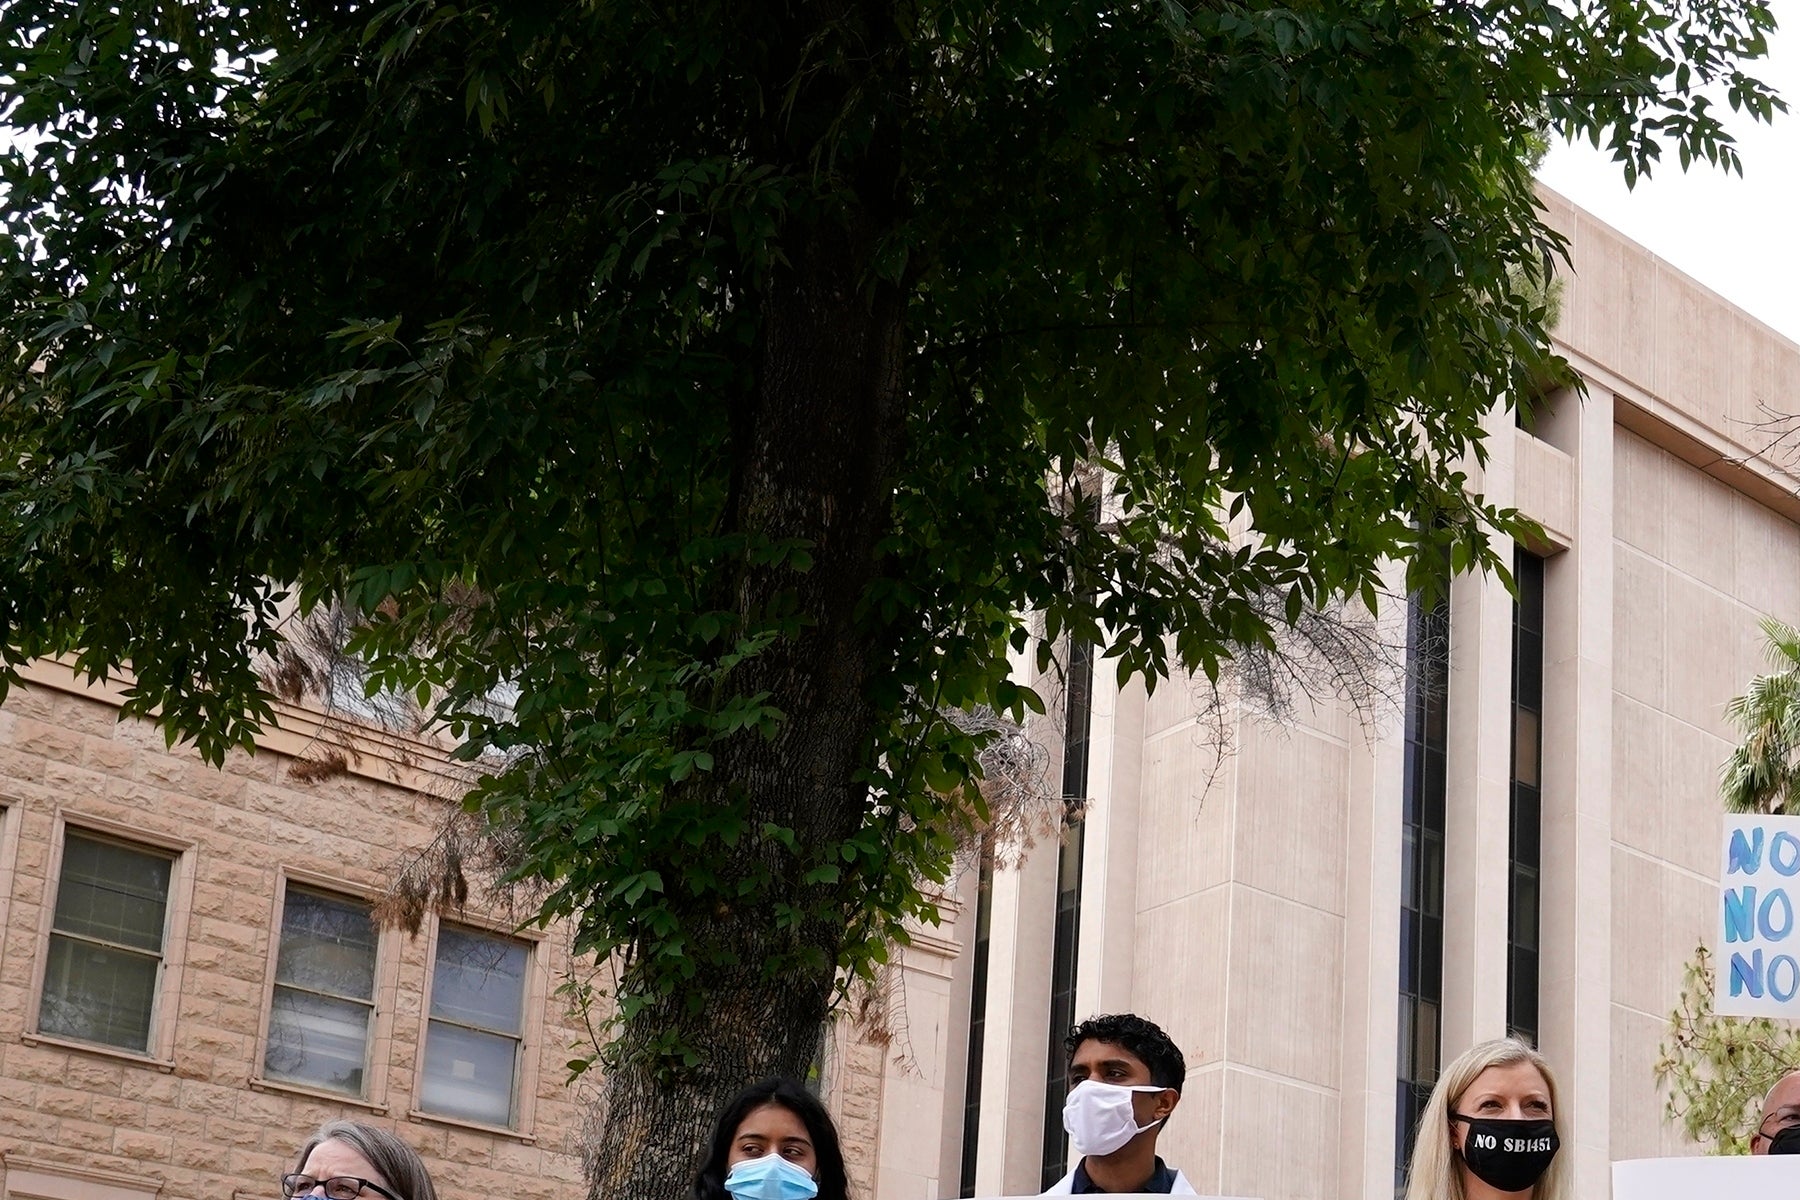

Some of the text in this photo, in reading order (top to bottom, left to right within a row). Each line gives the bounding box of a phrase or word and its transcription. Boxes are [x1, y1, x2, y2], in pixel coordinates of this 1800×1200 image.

[1724, 886, 1794, 943] NO
[1729, 948, 1800, 1003] NO
[1474, 1134, 1552, 1153] NO SB1457
